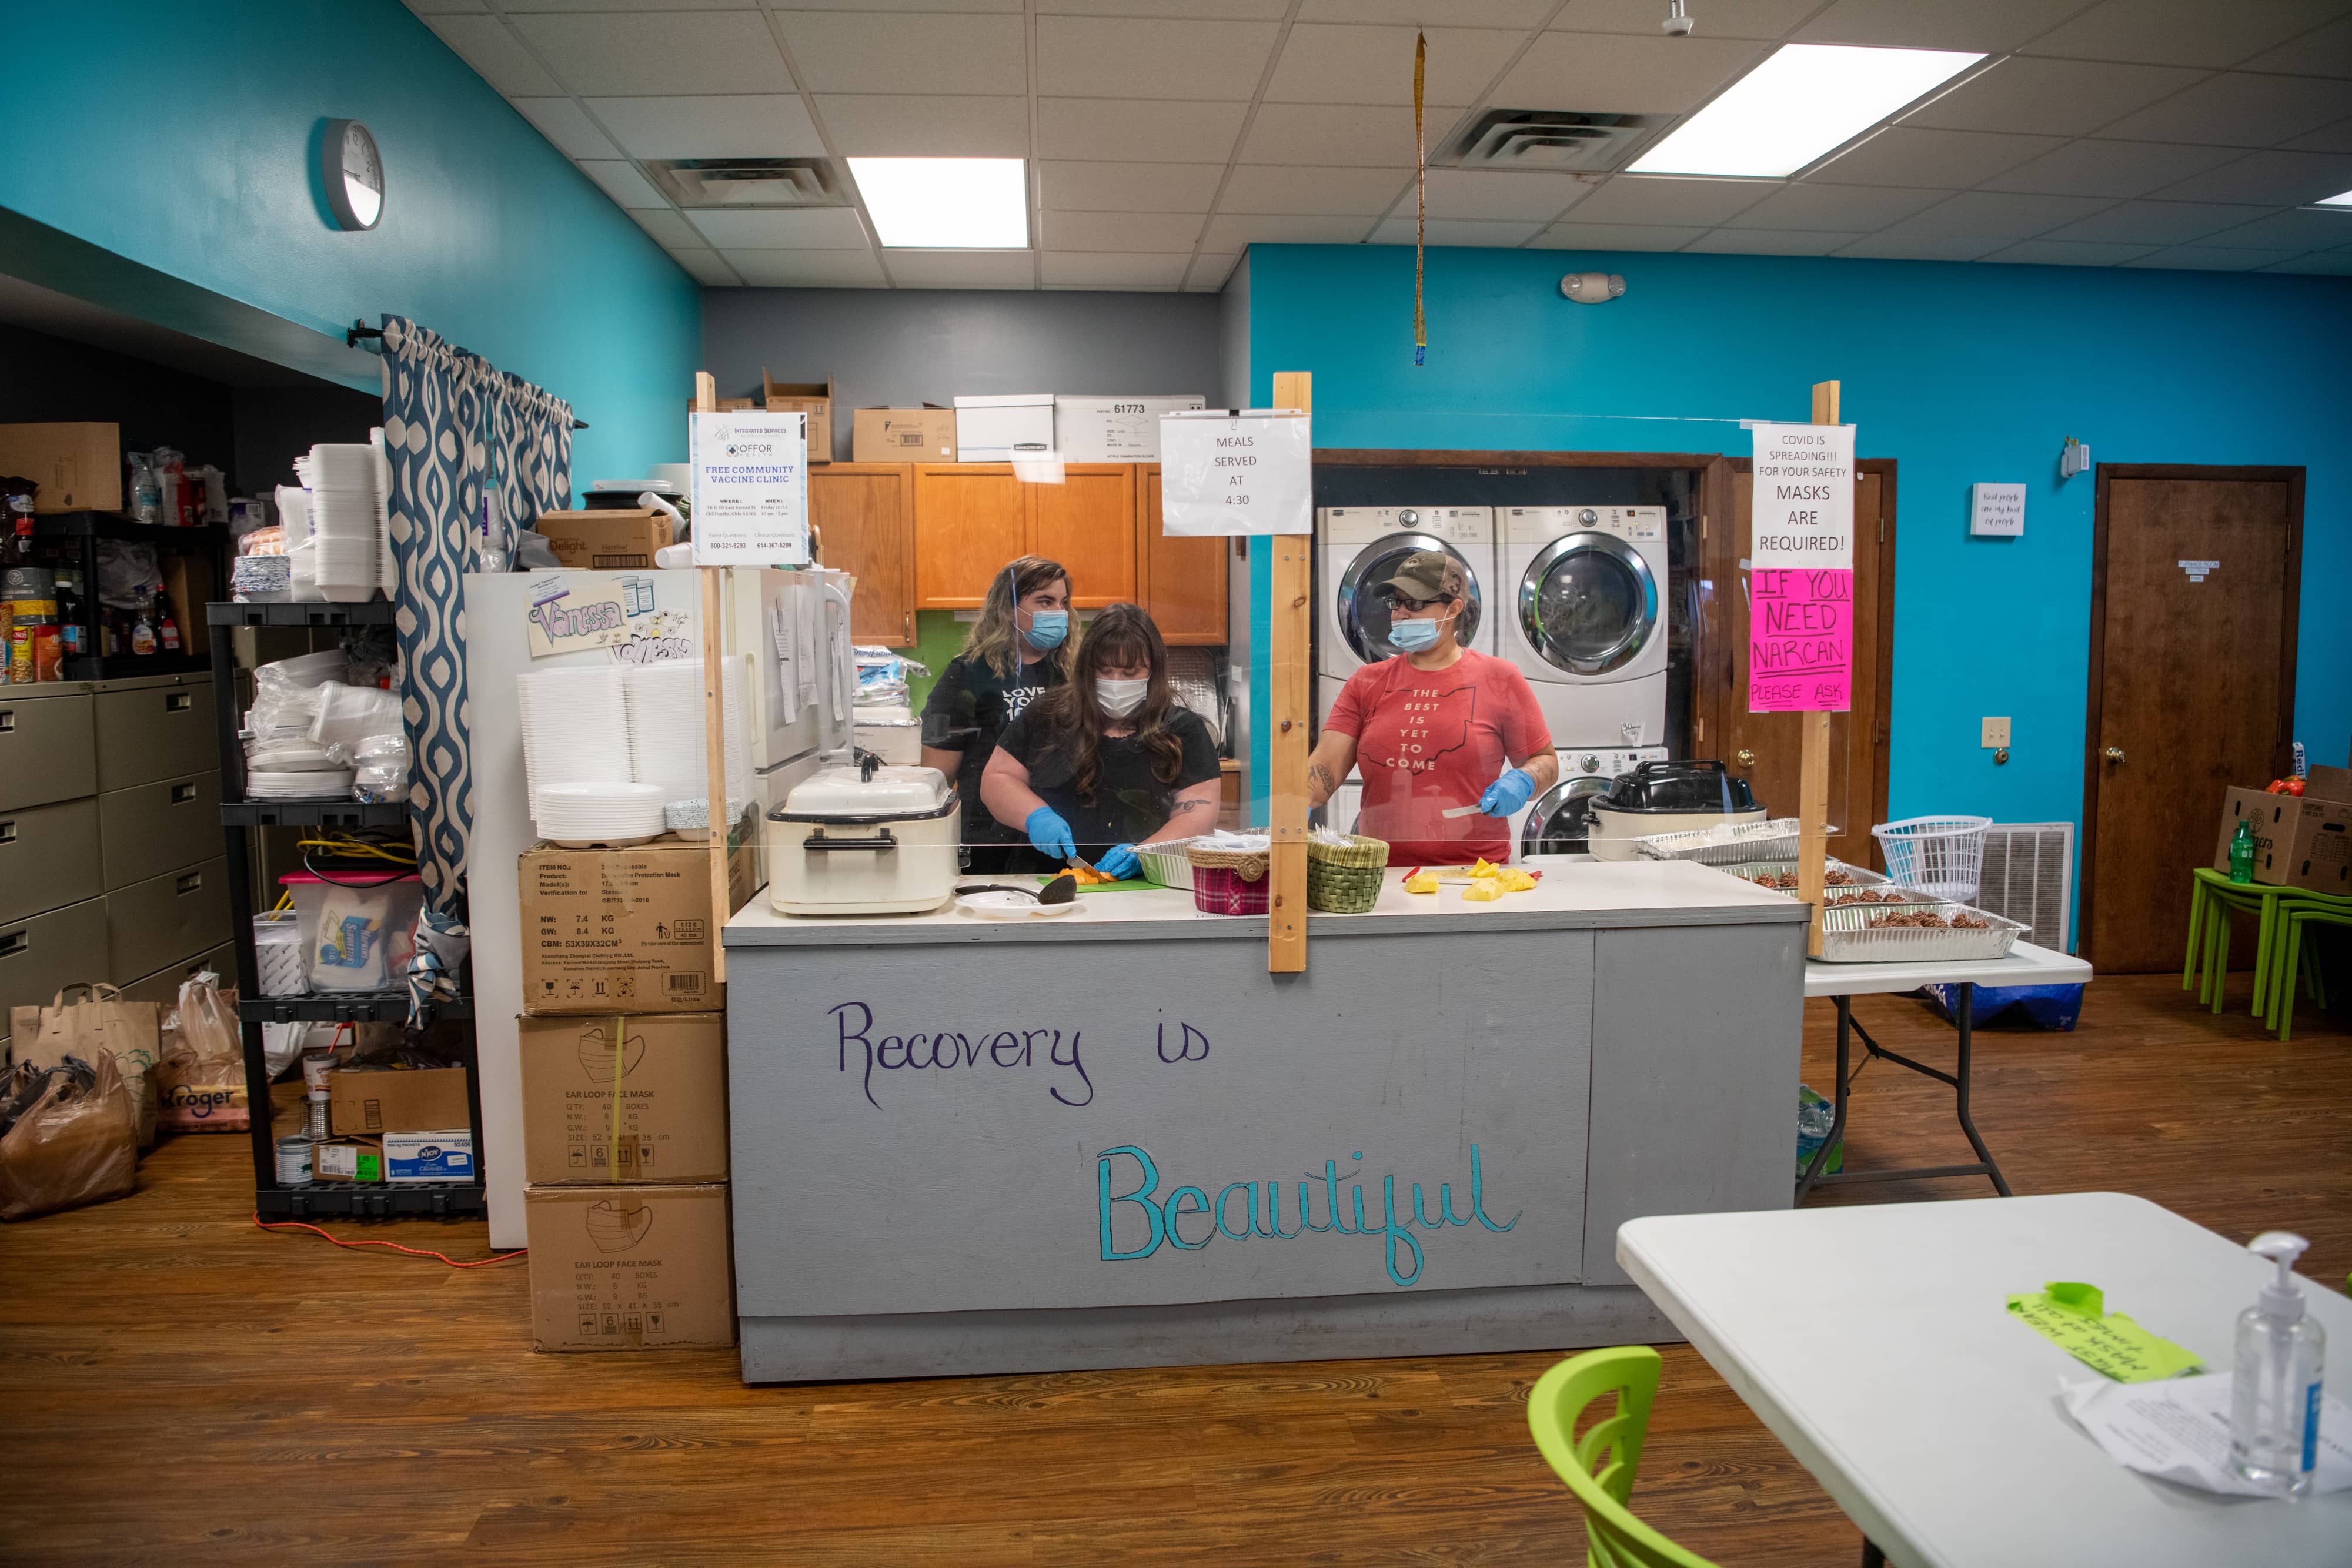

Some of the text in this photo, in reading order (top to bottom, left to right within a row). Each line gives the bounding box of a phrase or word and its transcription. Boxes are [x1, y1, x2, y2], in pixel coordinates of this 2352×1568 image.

[1114, 404, 1145, 413] 61773
[1217, 437, 1254, 447] MEALS
[1782, 436, 1825, 445] COVID IS
[1215, 456, 1257, 467] SERVED
[1769, 451, 1836, 461] SPREADING!!!
[1759, 467, 1846, 477] FOR YOUR SAFETY
[1230, 476, 1244, 486] AT
[1777, 486, 1830, 500] MASKS
[1225, 495, 1249, 505] 4:30
[1788, 511, 1818, 525] ARE
[549, 541, 588, 553] Delight
[1760, 536, 1844, 551] REQUIRED!
[1449, 574, 1462, 594] 3
[1755, 570, 1848, 599] IF YOU
[1766, 601, 1836, 634] NEED
[529, 601, 626, 648] Vanessa
[1753, 640, 1843, 669] NARCAN
[1002, 687, 1045, 697] LOVE
[1413, 689, 1439, 697] THE
[1751, 683, 1842, 701] PLEASE ASK
[1003, 697, 1034, 707] YO
[1399, 730, 1429, 738] YET
[1401, 743, 1422, 753] TO
[1386, 758, 1435, 771] COME
[2296, 750, 2305, 775] Redi
[827, 1001, 1210, 1110] Recovery is
[161, 1084, 233, 1118] Kroger
[596, 1148, 603, 1158] 6
[1098, 1142, 1524, 1288] Beautiful
[606, 1316, 614, 1325] 6
